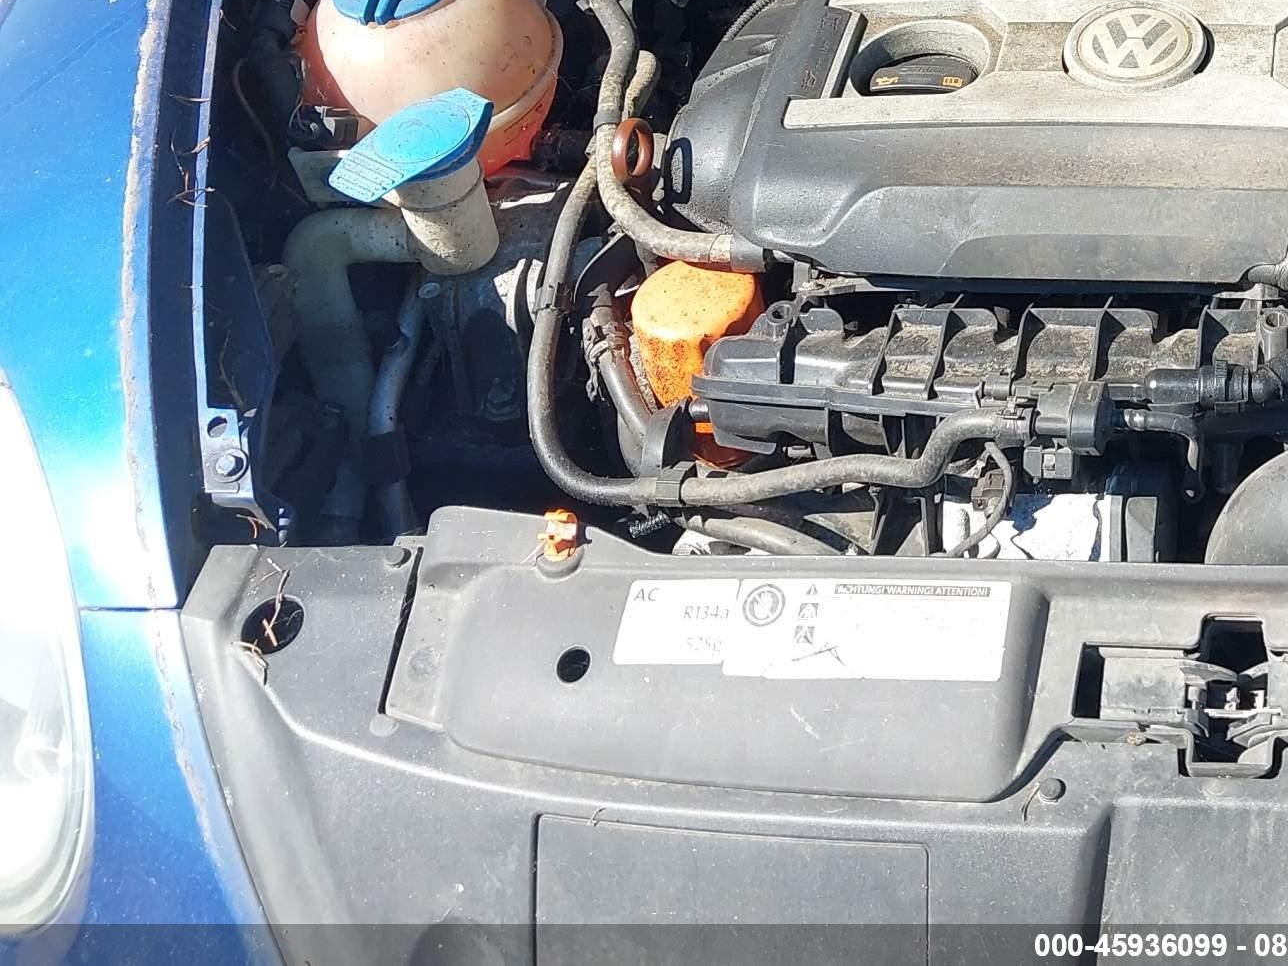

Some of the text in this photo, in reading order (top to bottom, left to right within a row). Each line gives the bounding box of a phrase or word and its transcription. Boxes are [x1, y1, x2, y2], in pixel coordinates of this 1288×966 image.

[633, 587, 660, 603] AC
[886, 585, 934, 596] WARNING!
[935, 586, 989, 597] ATTENTION!
[683, 604, 730, 620] R134a
